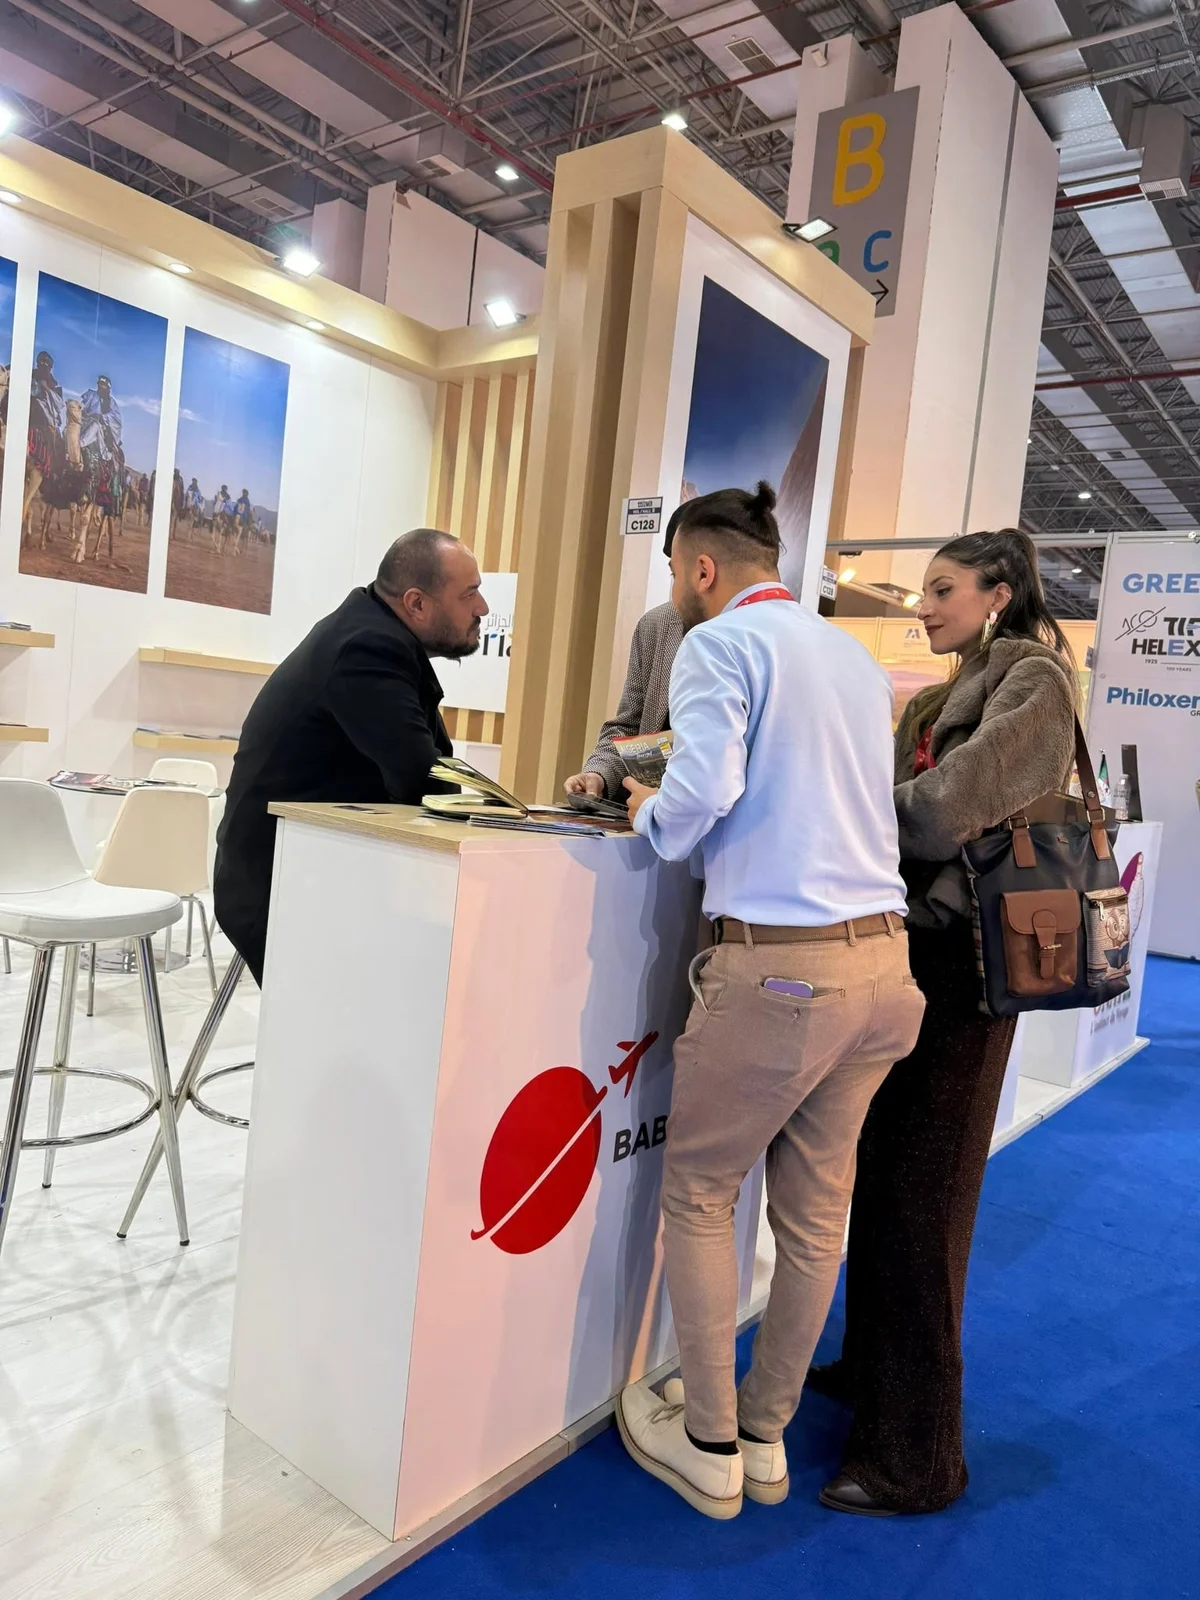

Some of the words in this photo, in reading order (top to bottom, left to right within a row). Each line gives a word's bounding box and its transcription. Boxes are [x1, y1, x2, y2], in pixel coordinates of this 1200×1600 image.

[832, 112, 887, 207] B
[631, 519, 655, 531] C128
[613, 1114, 668, 1163] BAB
